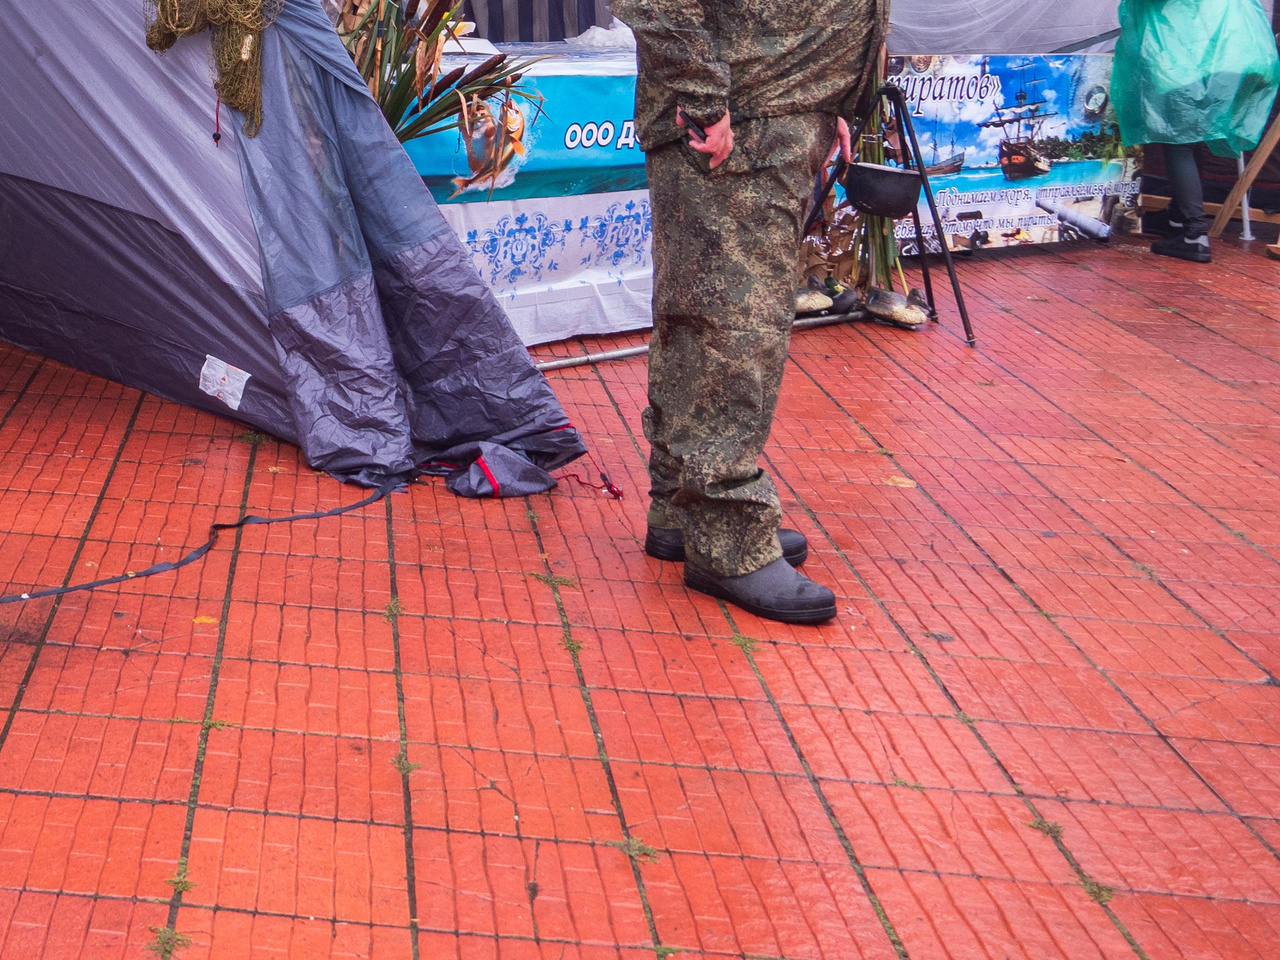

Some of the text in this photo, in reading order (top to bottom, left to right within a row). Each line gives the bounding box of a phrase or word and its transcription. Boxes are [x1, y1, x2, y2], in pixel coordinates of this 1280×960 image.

[565, 120, 615, 149] ООО
[934, 186, 997, 208] Поднимаем
[937, 220, 975, 239] отому
[996, 215, 1016, 231] мы
